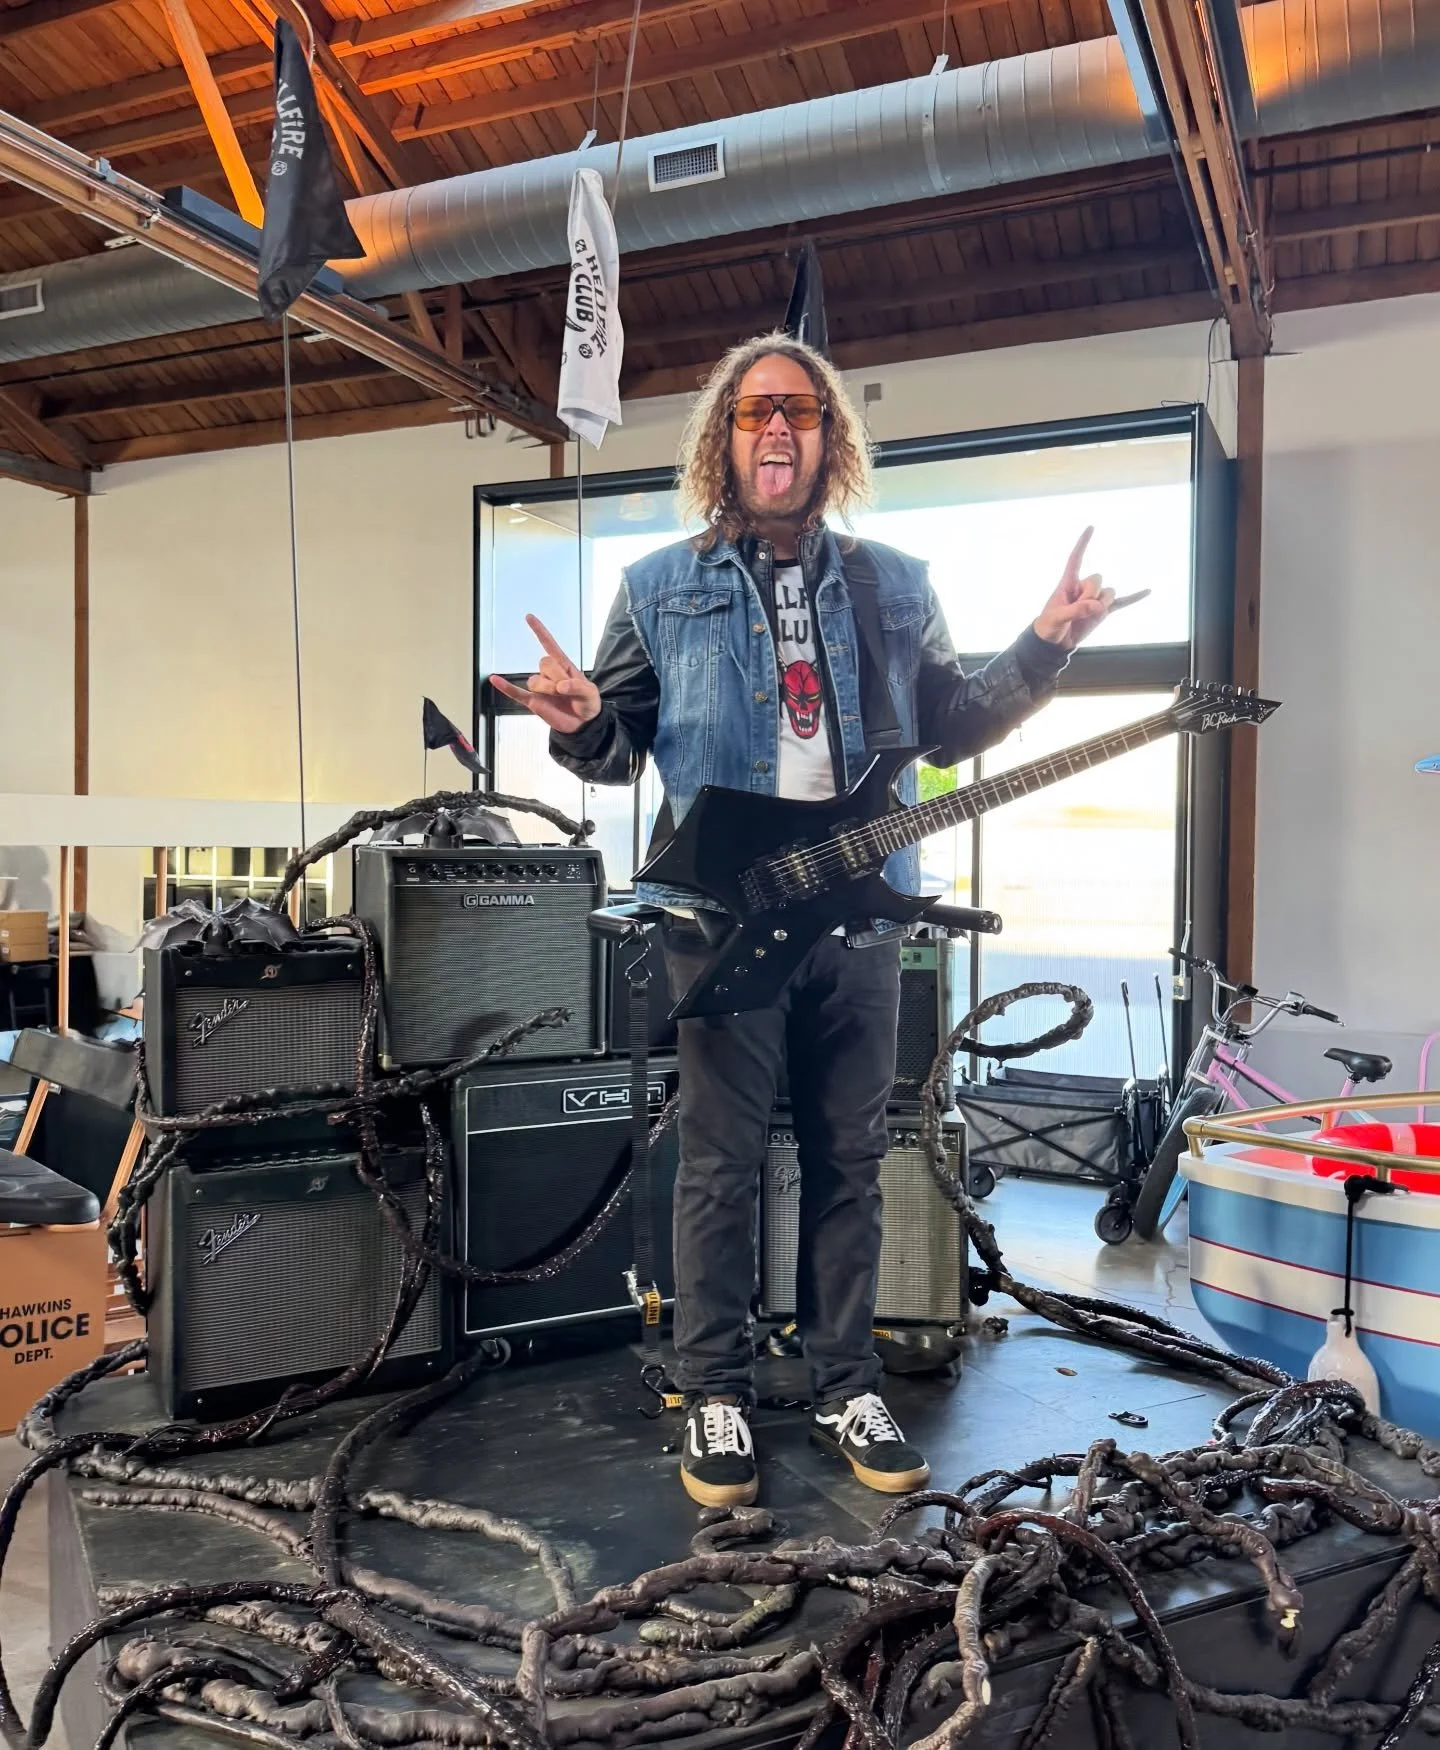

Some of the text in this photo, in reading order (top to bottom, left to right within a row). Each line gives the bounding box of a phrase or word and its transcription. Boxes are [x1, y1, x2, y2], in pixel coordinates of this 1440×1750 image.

[575, 273, 594, 323] CLUB
[780, 619, 809, 645] LU
[479, 895, 535, 906] GAMMA
[188, 998, 249, 1048] Fender
[198, 1213, 261, 1264] Fender
[0, 1299, 72, 1320] HAWKINS
[0, 1313, 90, 1348] OLICE
[14, 1348, 54, 1364] DEPT.
